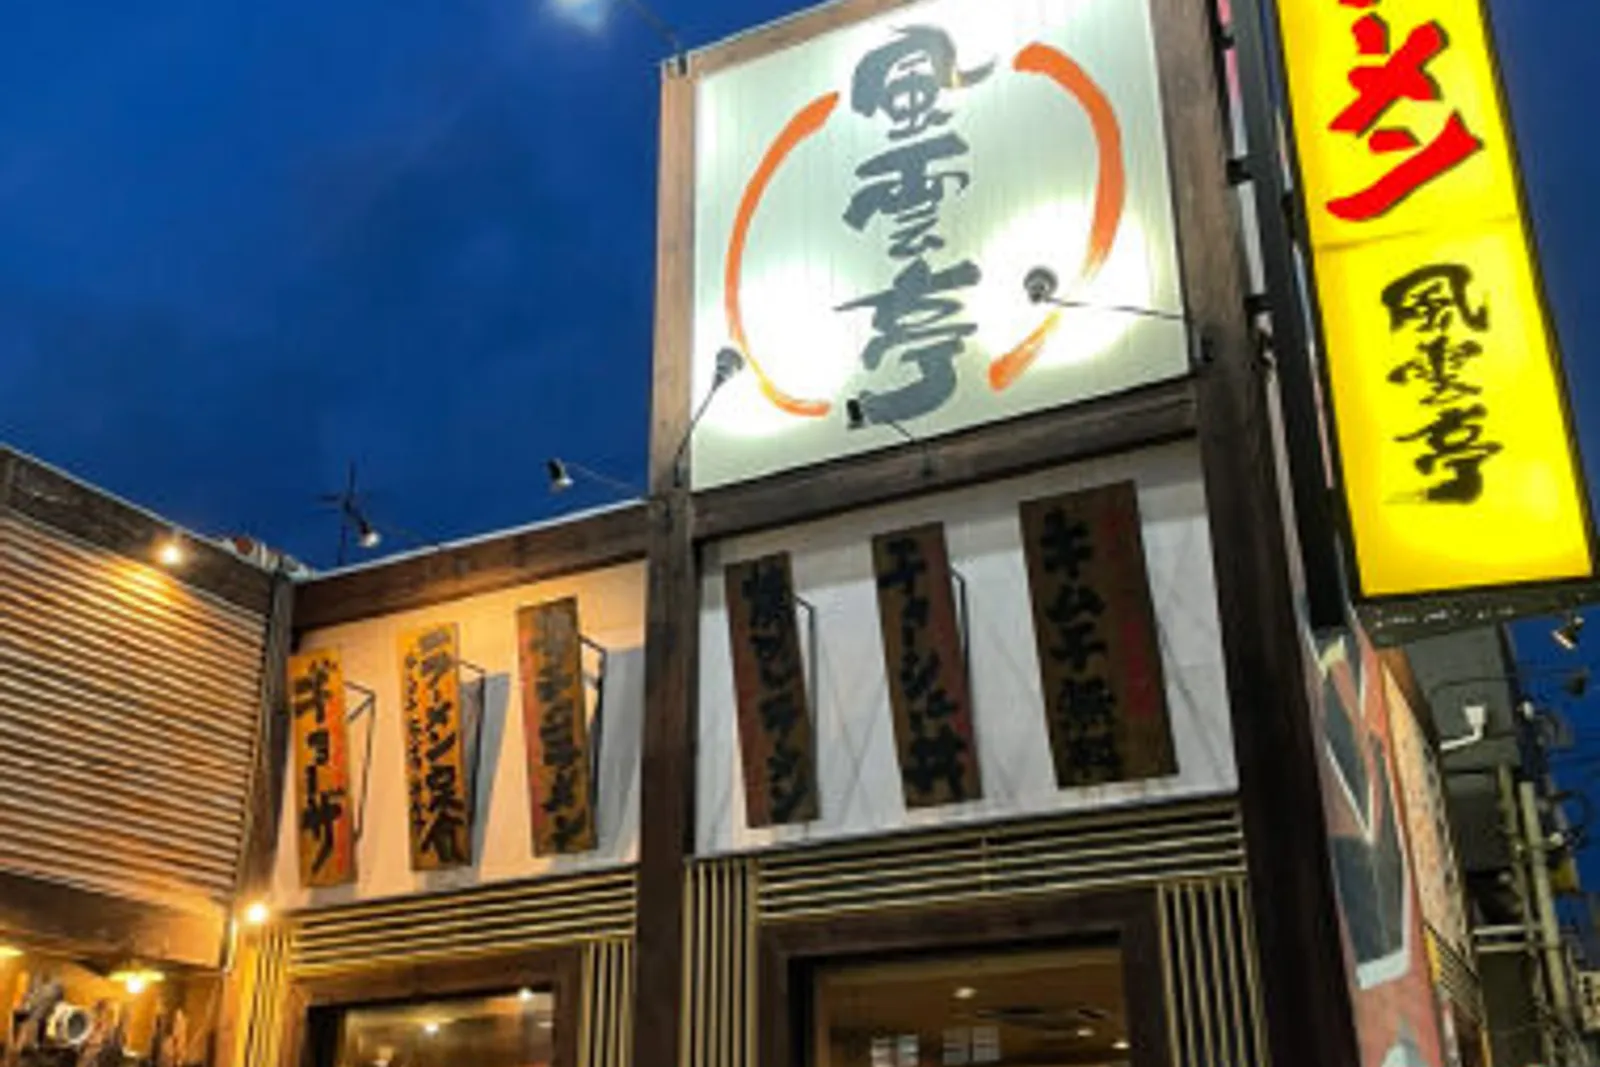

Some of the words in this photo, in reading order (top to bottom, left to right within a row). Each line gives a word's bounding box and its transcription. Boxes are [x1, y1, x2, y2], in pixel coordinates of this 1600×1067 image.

[834, 24, 997, 426] 風雲亭
[1325, 0, 1483, 222] ーメン
[1382, 263, 1504, 505] 風雲亭
